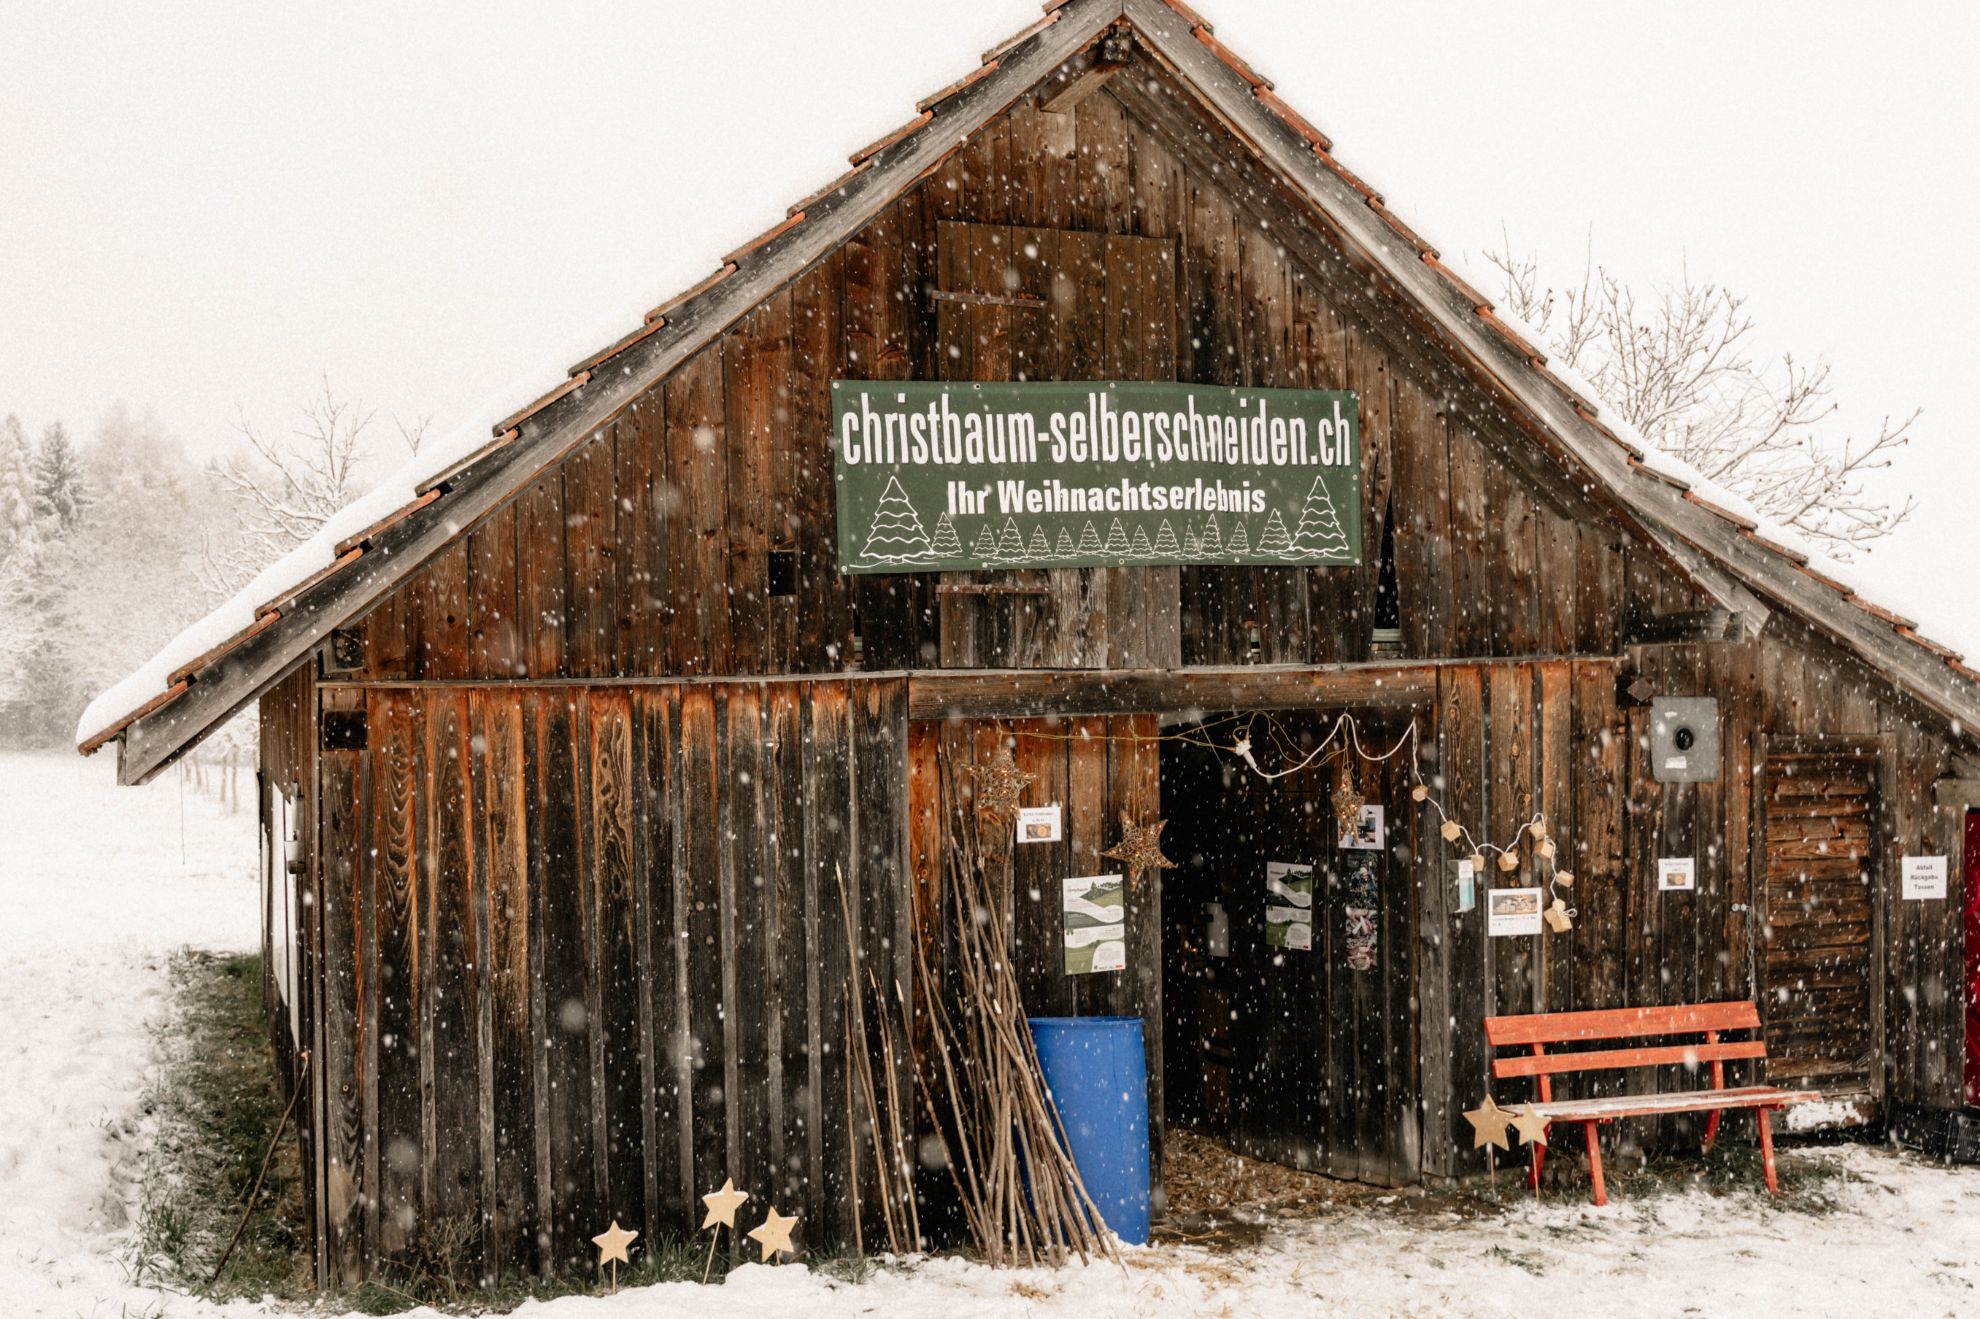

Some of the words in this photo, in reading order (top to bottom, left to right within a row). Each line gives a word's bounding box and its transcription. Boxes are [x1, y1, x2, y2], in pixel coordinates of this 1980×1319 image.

[842, 392, 1351, 466] christbaum-selberschneiden.ch
[947, 481, 988, 515] Ihr
[998, 479, 1266, 514] Weihnachtserlebnis
